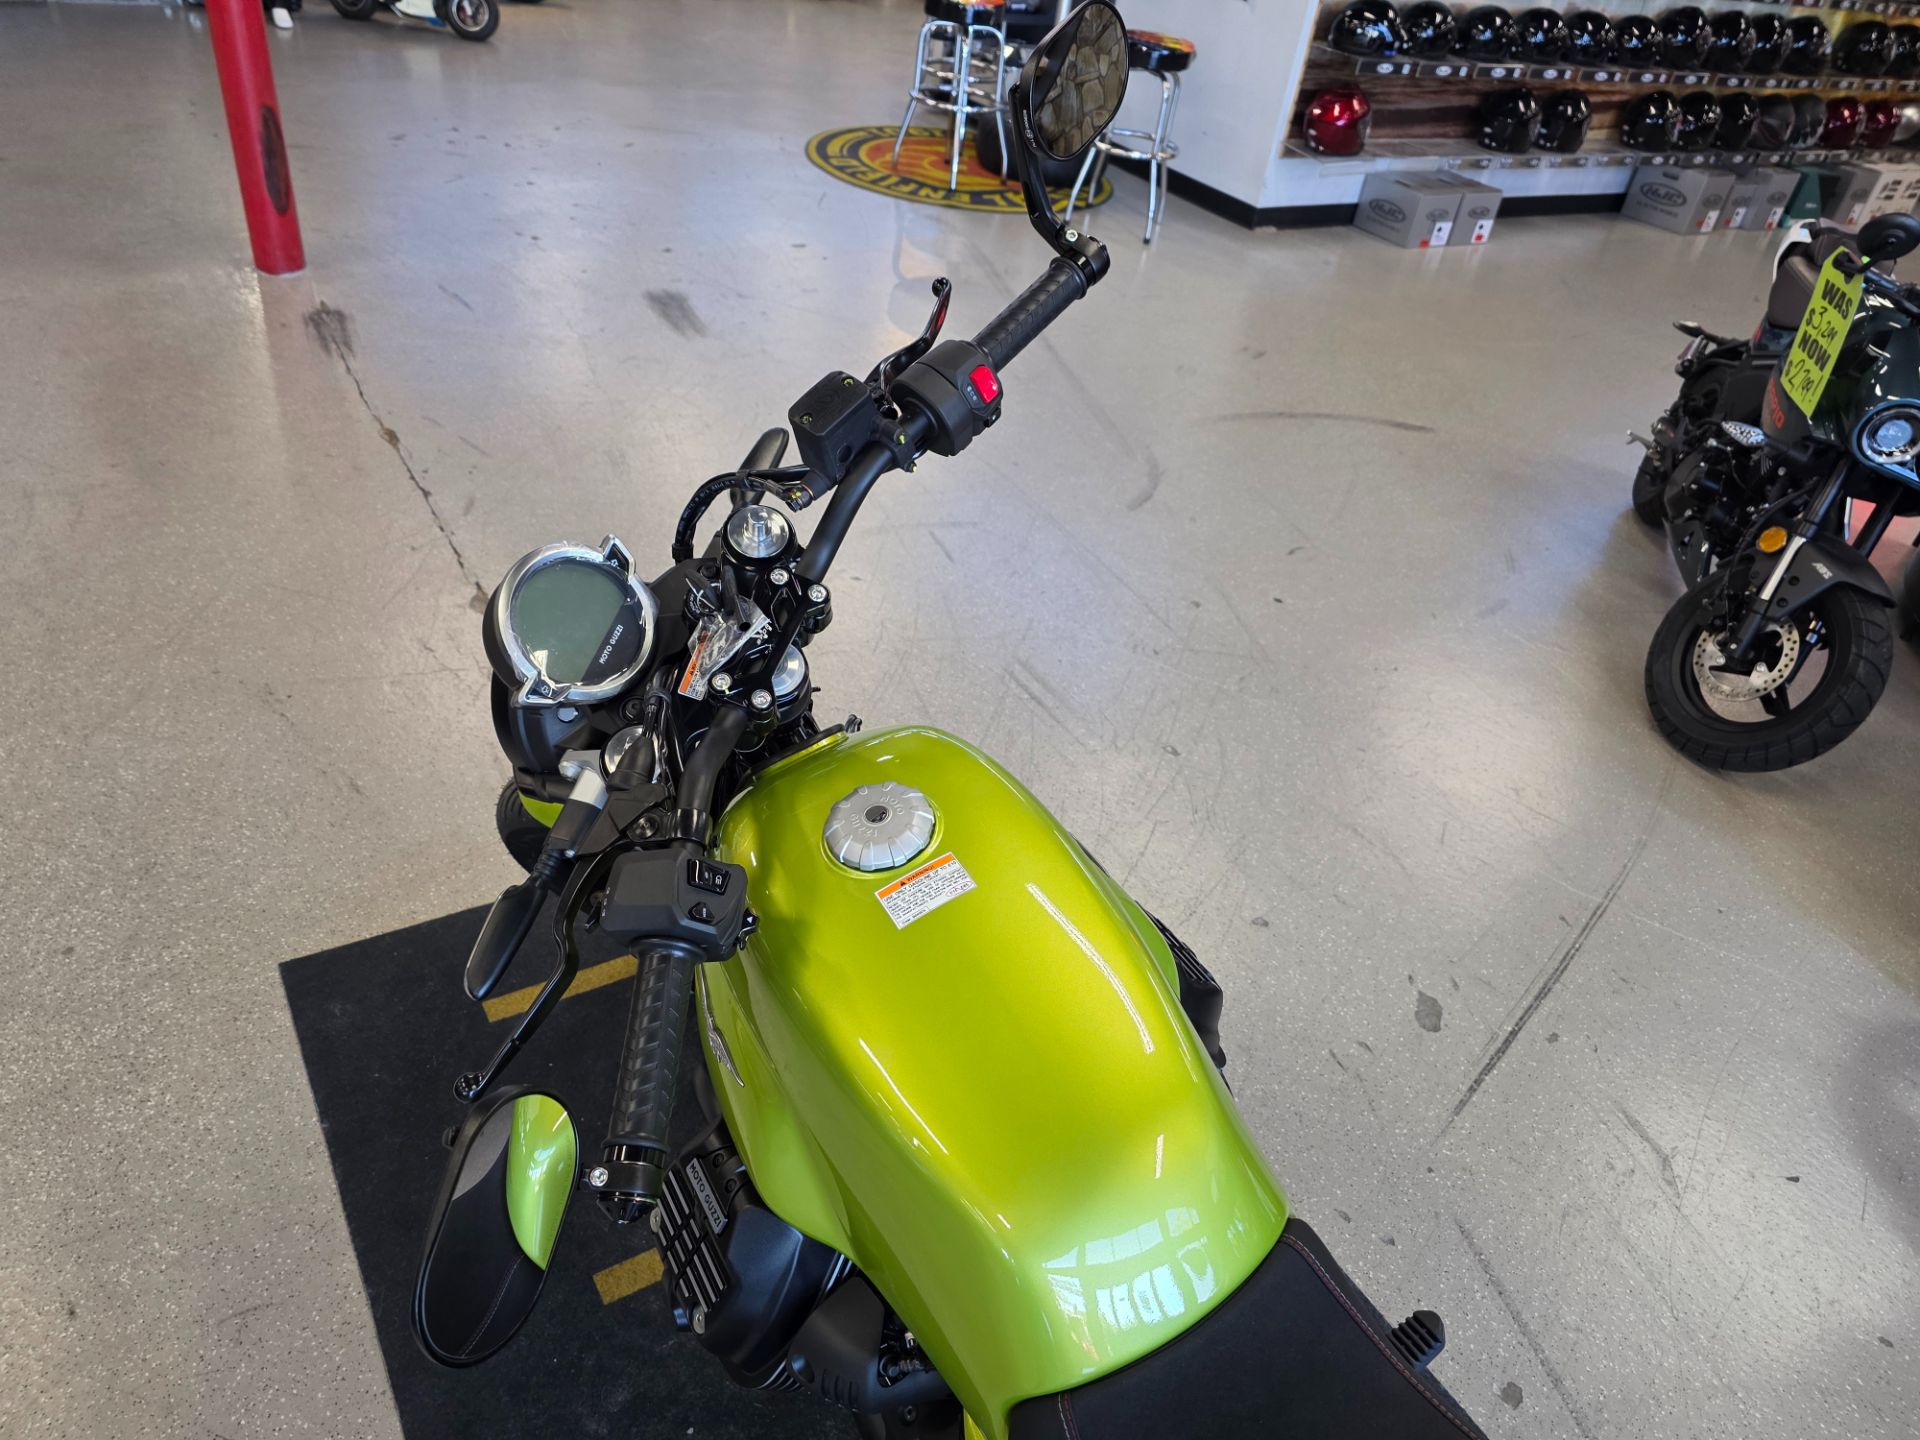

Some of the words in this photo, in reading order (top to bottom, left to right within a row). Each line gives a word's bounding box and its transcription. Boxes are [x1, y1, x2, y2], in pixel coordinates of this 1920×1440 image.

[1821, 278, 1853, 320] WAS
[1805, 306, 1838, 347] $3,299
[1798, 330, 1831, 371] NOW
[599, 645, 613, 665] MOTO
[609, 624, 624, 645] GUZZI
[689, 1162, 706, 1193] MOTO
[704, 1193, 722, 1227] GUZZI
